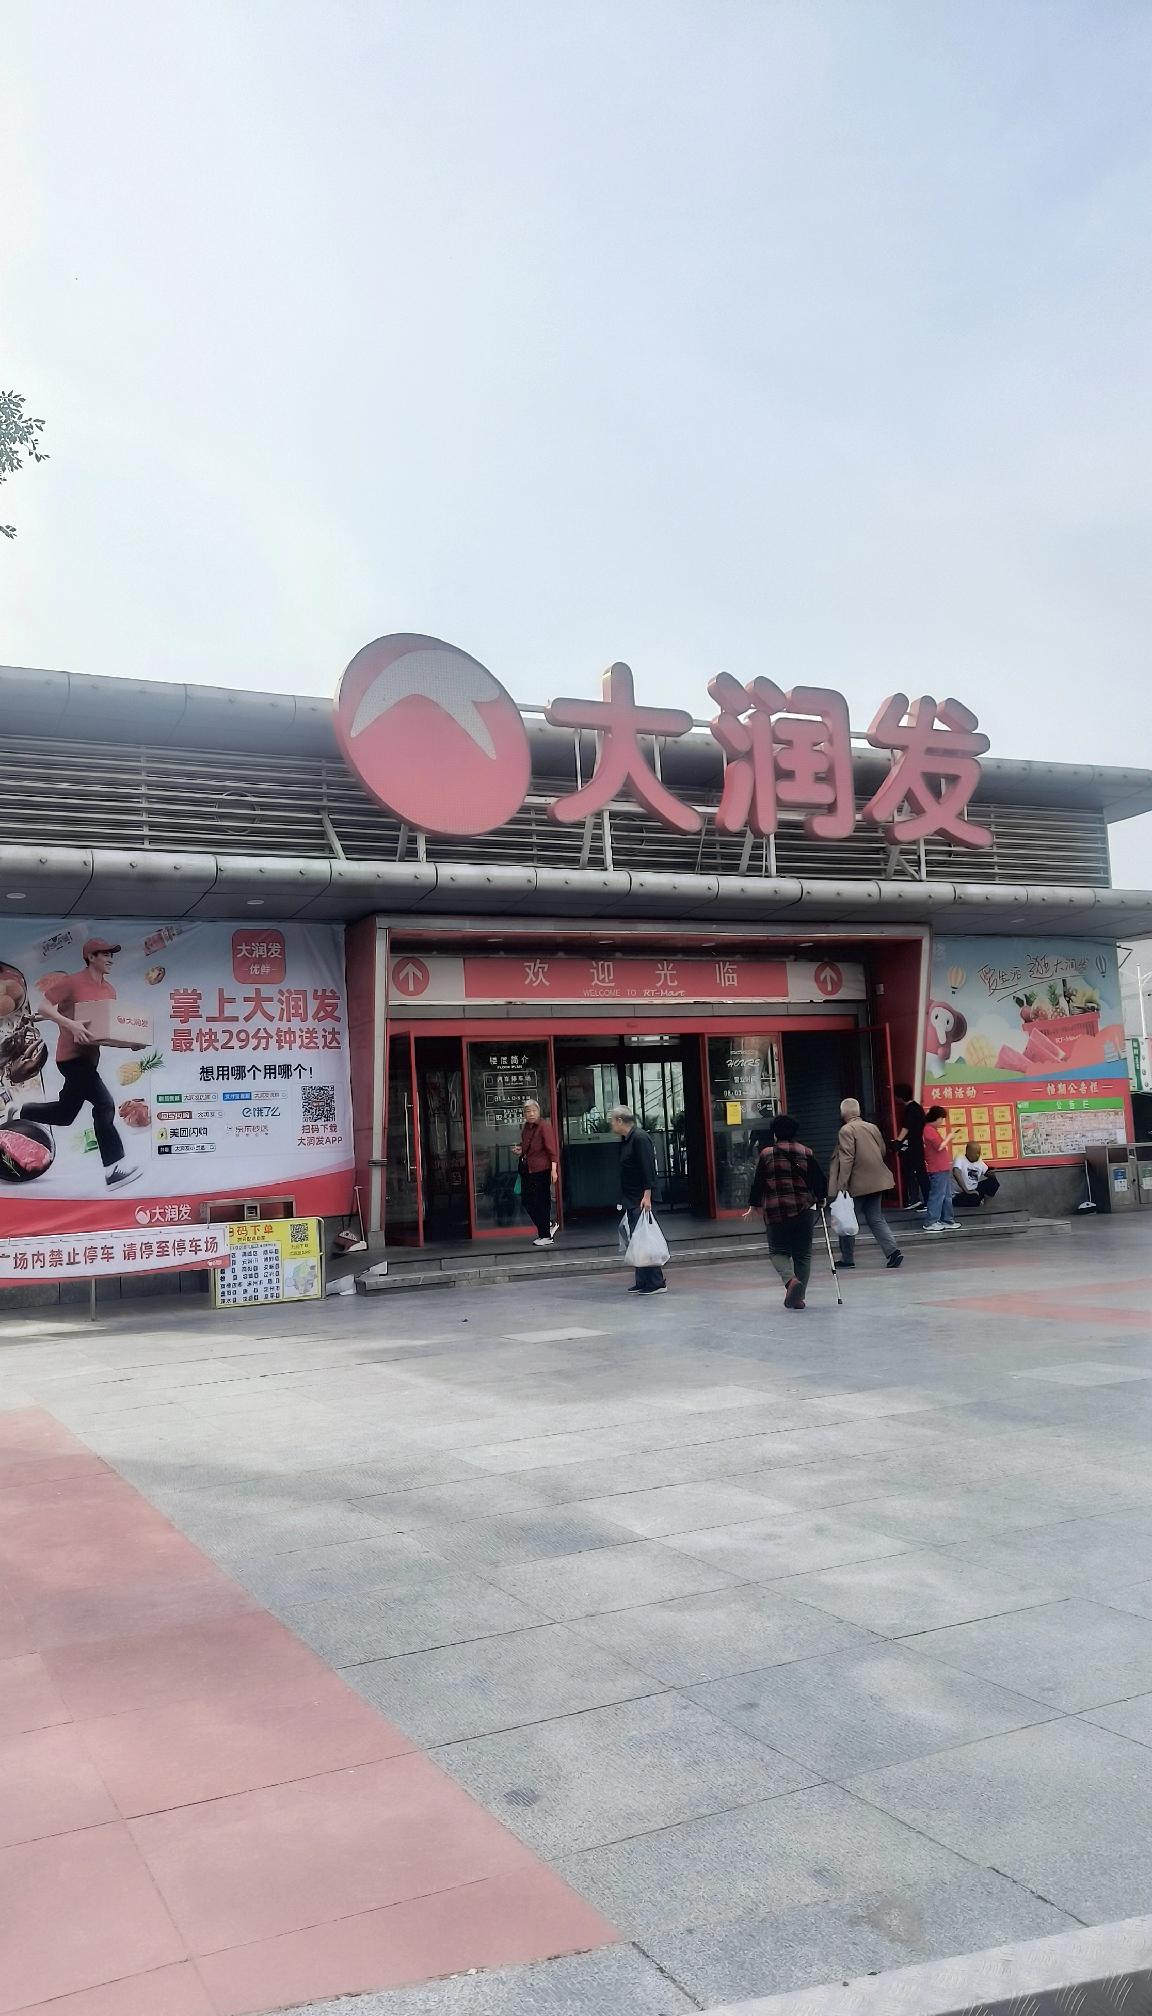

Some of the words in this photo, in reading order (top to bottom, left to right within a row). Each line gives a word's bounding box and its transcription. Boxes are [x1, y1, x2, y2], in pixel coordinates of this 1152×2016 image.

[546, 662, 994, 850] 大润发
[237, 942, 283, 958] 大润发
[249, 963, 271, 975] 优鲜
[524, 958, 738, 987] 欢迎光临
[643, 989, 686, 998] RT-Mart
[169, 987, 342, 1025] 掌上大润发
[171, 1027, 342, 1053] 最快29分钟送达
[199, 1063, 314, 1082] 想用哪个用哪个!
[169, 1127, 208, 1138] 美团闪购
[302, 1124, 338, 1134] 扫码下载
[297, 1136, 343, 1147] 大润发APP
[151, 1204, 192, 1222] 大润发
[0, 1244, 114, 1270] 场内禁止停车
[123, 1236, 218, 1262] 请停至停车场
